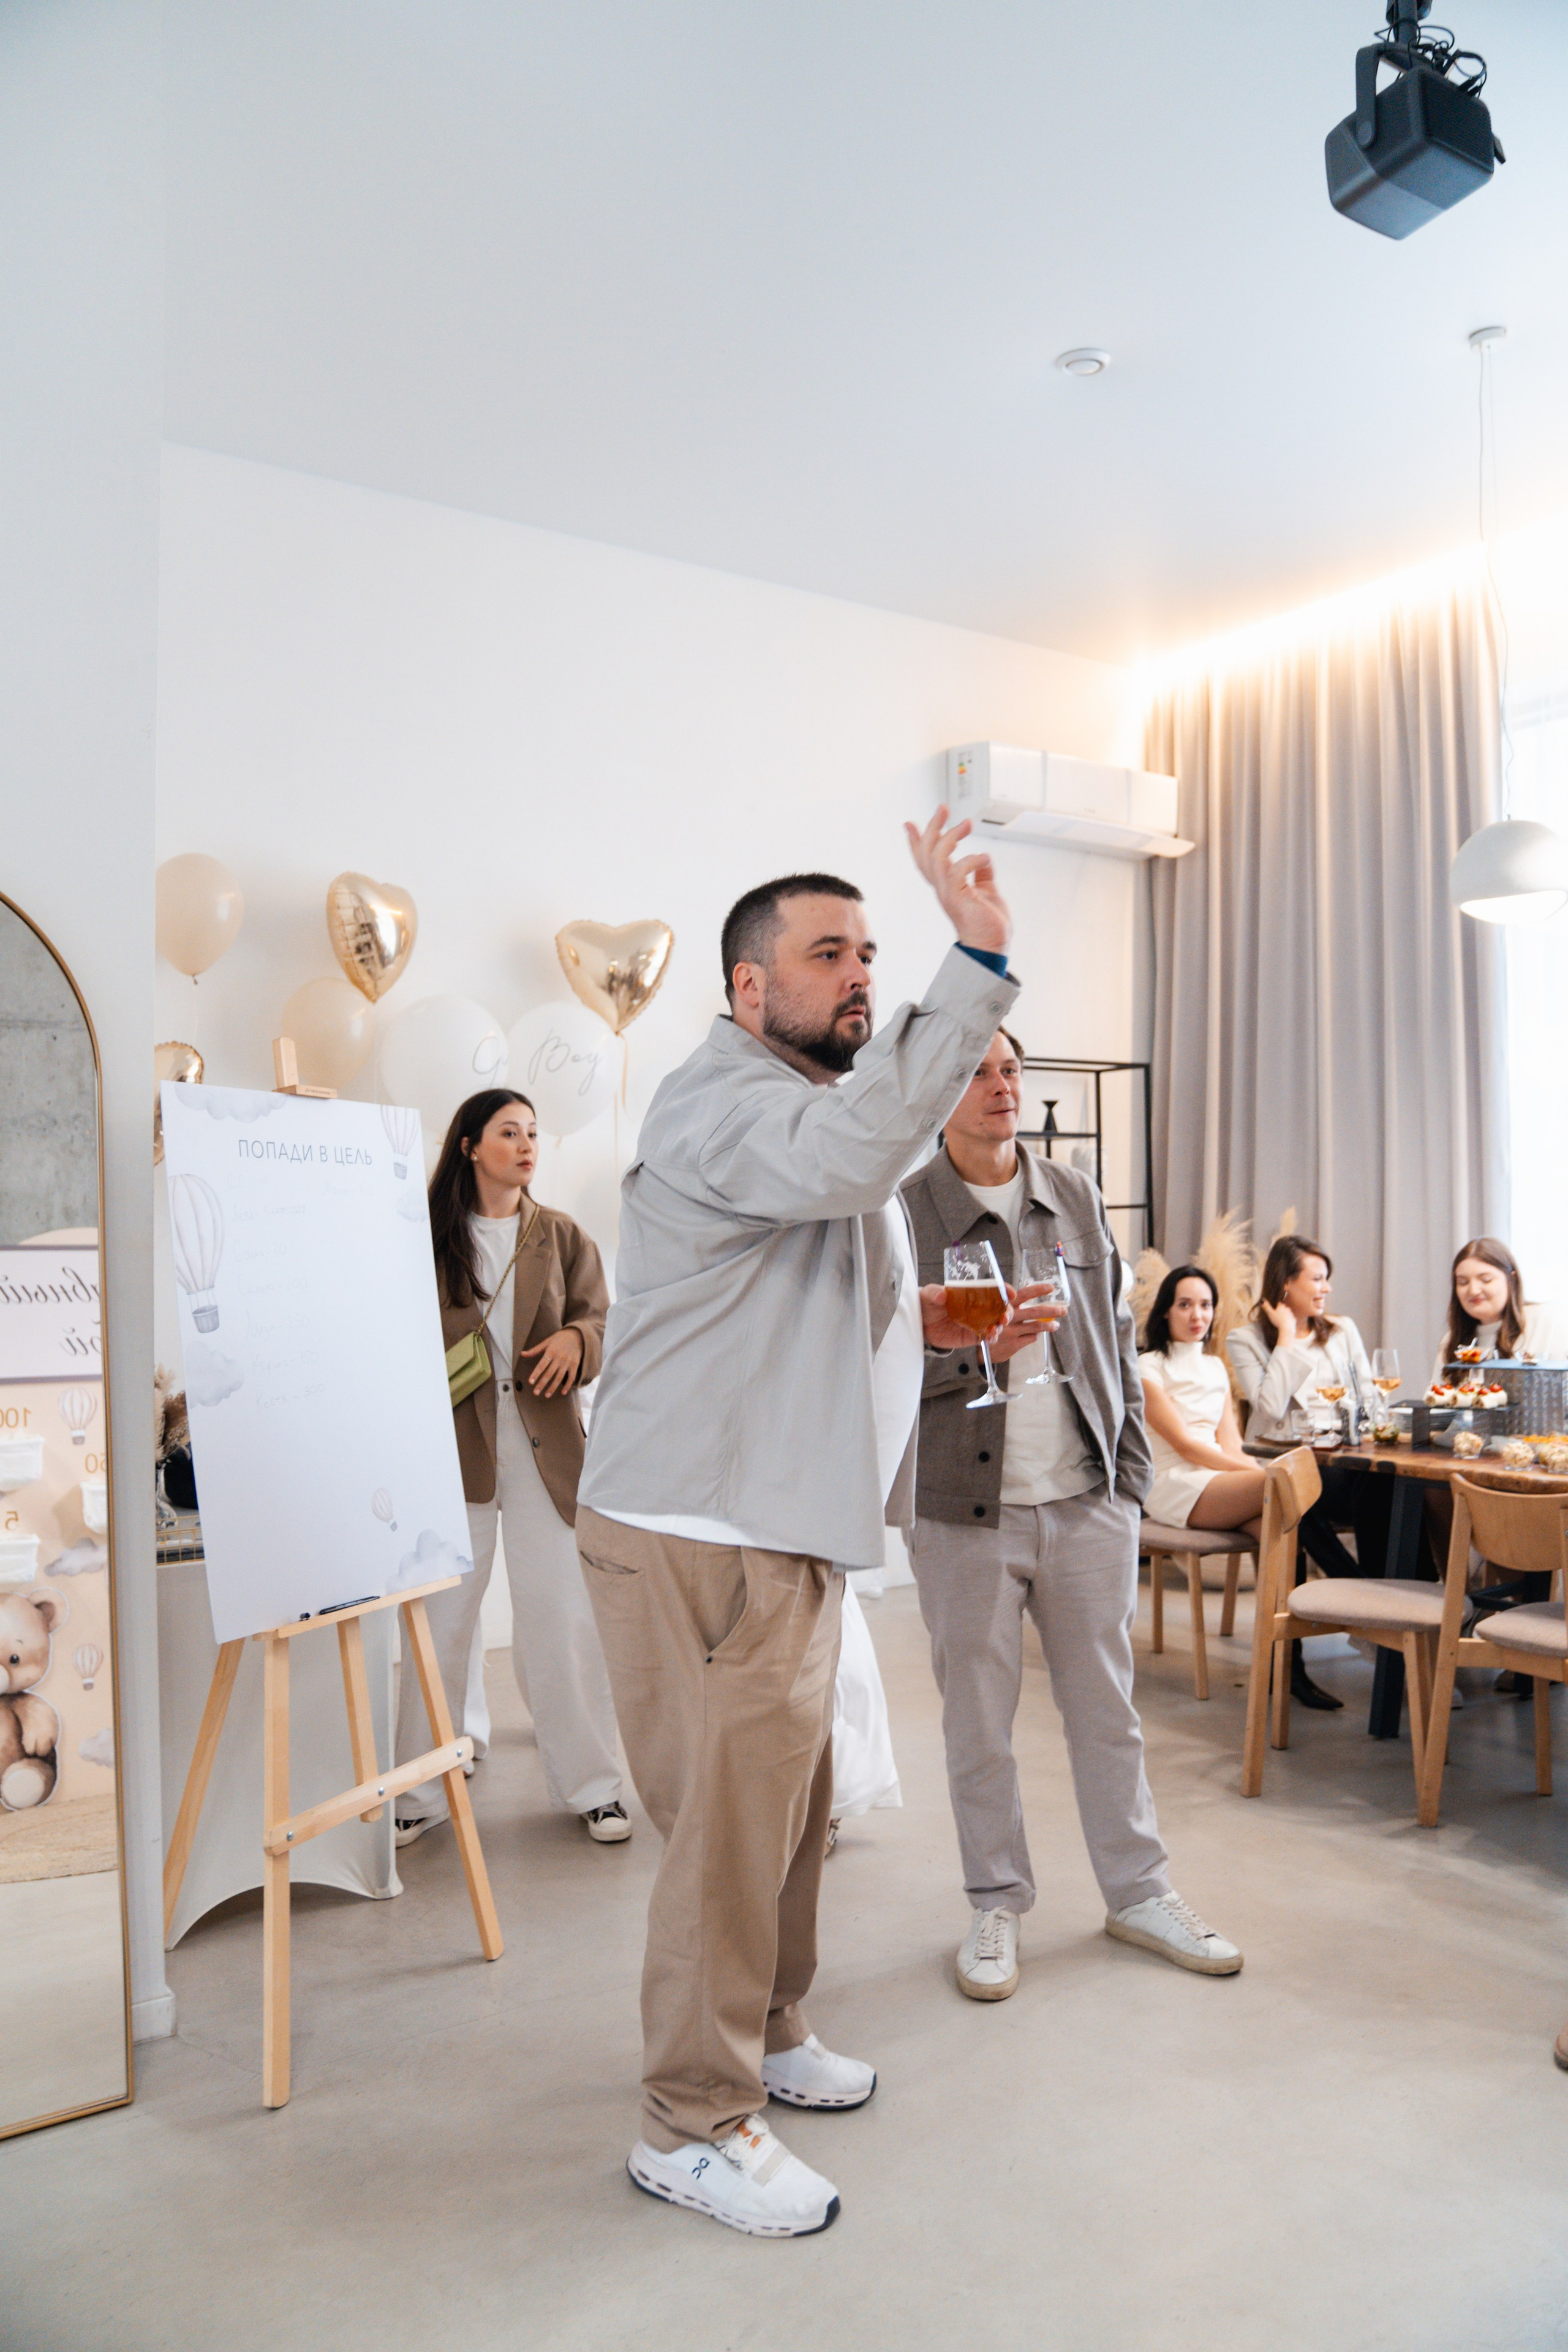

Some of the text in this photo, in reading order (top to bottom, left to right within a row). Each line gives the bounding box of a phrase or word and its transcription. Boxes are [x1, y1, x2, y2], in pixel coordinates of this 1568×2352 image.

[238, 1139, 372, 1166] ПОПАДИ В ЦЕЛЬ
